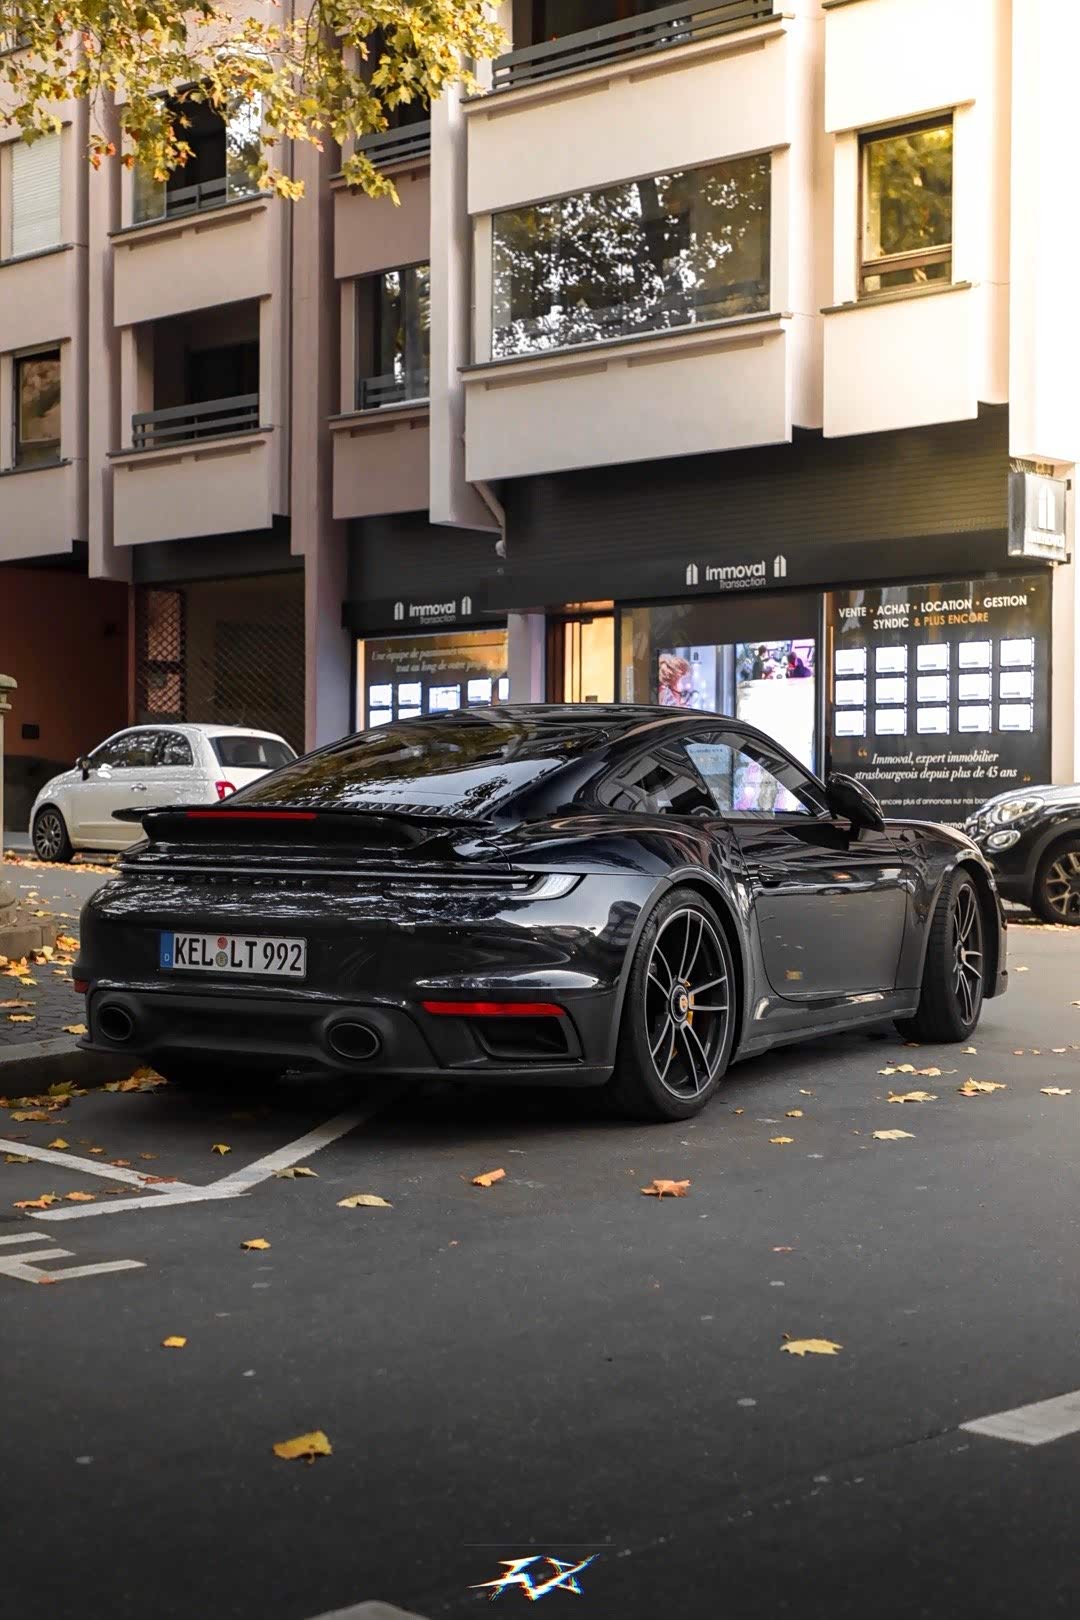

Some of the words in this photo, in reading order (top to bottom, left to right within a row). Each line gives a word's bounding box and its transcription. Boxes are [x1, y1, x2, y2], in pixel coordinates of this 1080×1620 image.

[719, 577, 766, 590] Transaction
[838, 606, 867, 619] VENTE
[876, 603, 910, 616] ACHAT
[920, 599, 973, 613] LOCATION
[983, 595, 1028, 609] GESTION
[872, 617, 910, 630] SYNDIC
[914, 616, 921, 627] &
[923, 614, 945, 626] PLUS
[948, 611, 989, 624] ENCORE
[871, 751, 915, 766] Immoval,
[915, 751, 946, 767] expert
[946, 749, 999, 763] immobilier
[854, 766, 918, 783] strasbourgeois
[918, 766, 949, 783] depuis
[949, 765, 971, 781] plus
[971, 764, 986, 778] de
[986, 764, 999, 777] 45
[999, 767, 1018, 777] ans
[902, 798, 915, 806] plus
[164, 954, 170, 962] D
[174, 936, 214, 967] KEL
[230, 939, 258, 968] LT
[262, 941, 303, 972] 992
